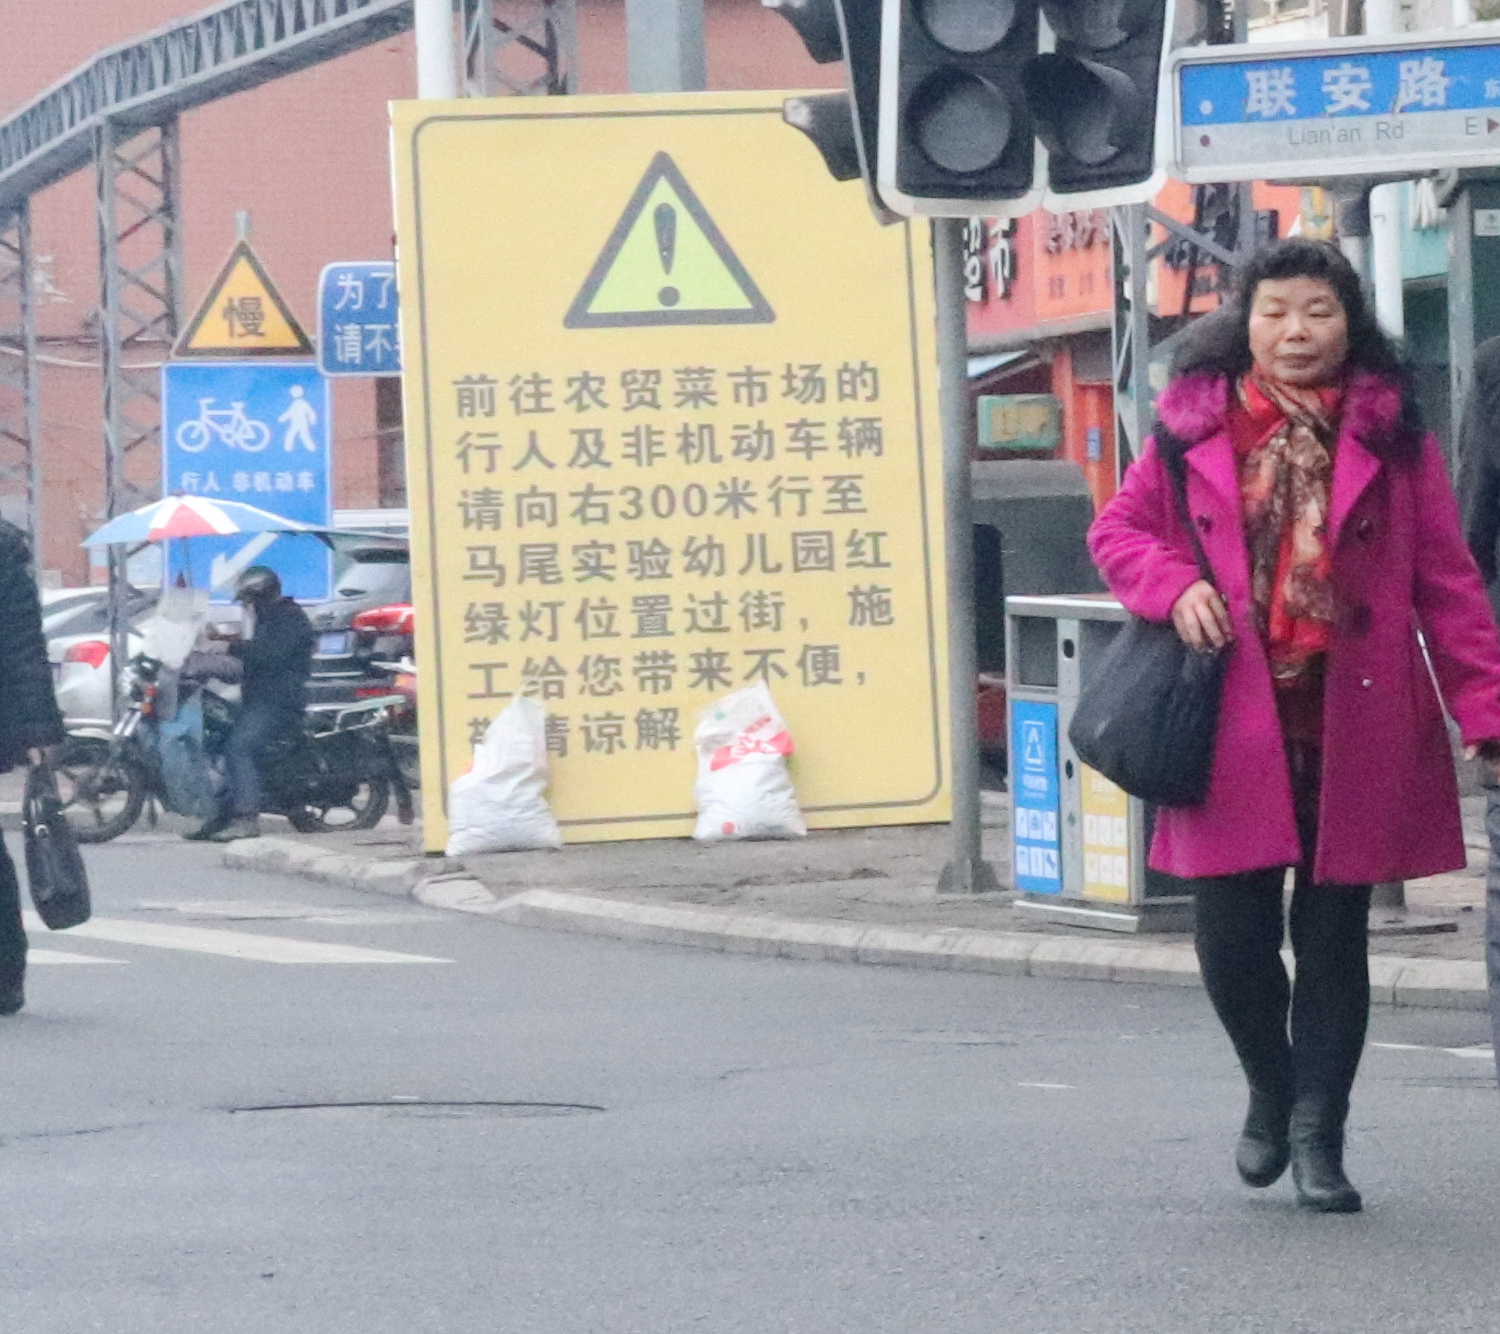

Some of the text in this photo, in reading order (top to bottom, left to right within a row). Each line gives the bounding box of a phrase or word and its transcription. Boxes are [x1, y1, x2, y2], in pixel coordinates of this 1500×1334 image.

[1244, 57, 1450, 117] 联安路
[1287, 117, 1477, 146] Lian'an Rd E
[223, 296, 265, 339] 慢
[334, 272, 395, 311] 为了
[334, 323, 401, 364] 请不
[452, 360, 881, 418] 前往农贸菜市场的
[455, 416, 885, 474] 行人及非机动车辆
[457, 473, 868, 532] 请向右300米行至
[462, 528, 892, 588] 马尾实验幼儿园红
[462, 584, 896, 645] 绿灯位置过街，施
[467, 643, 867, 701] 工给您带来不便，
